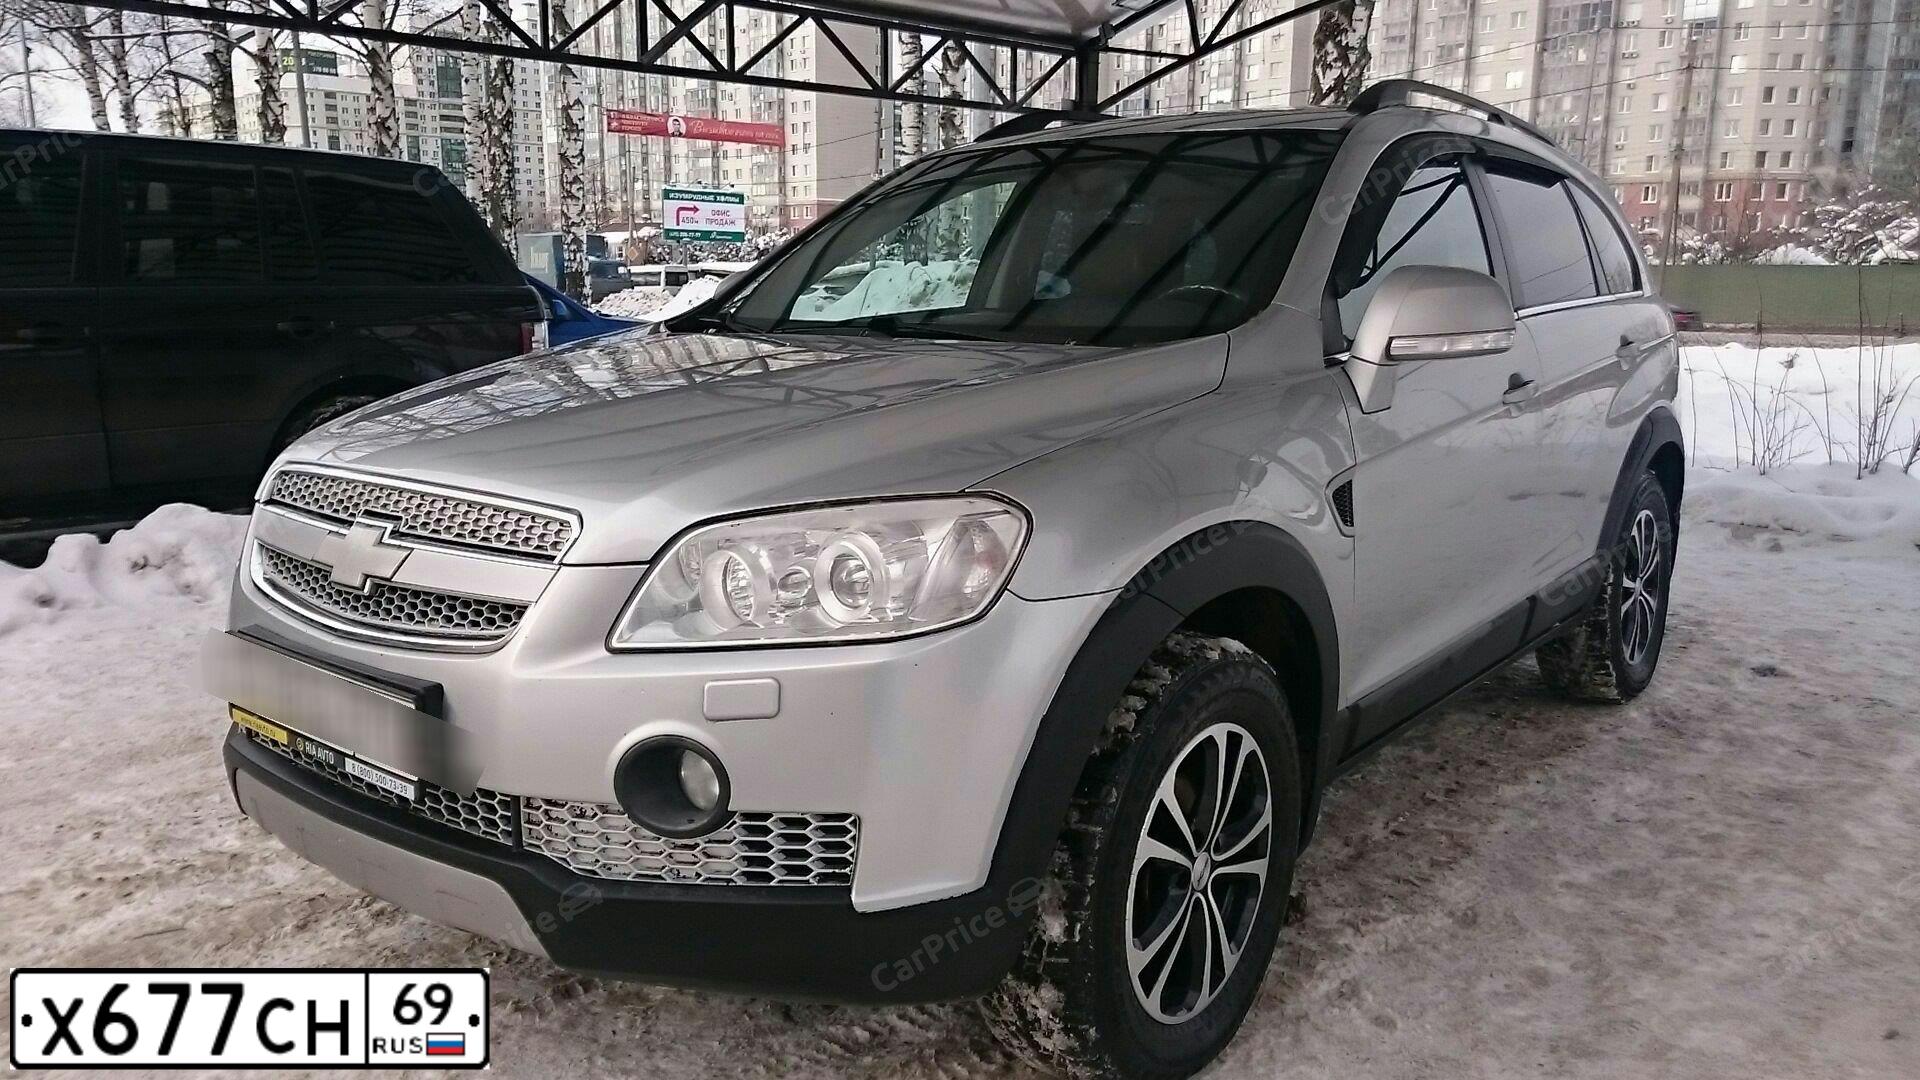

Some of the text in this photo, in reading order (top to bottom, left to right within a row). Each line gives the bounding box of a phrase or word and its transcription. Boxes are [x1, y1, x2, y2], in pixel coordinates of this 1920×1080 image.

[668, 192, 715, 202] ИЗУМРУДНЫЕ
[711, 209, 731, 217] ОФИС
[705, 217, 736, 227] ПРОДАЖ
[305, 742, 334, 765] RIA AVTO
[351, 763, 408, 796] 8 (800) 500-73-39
